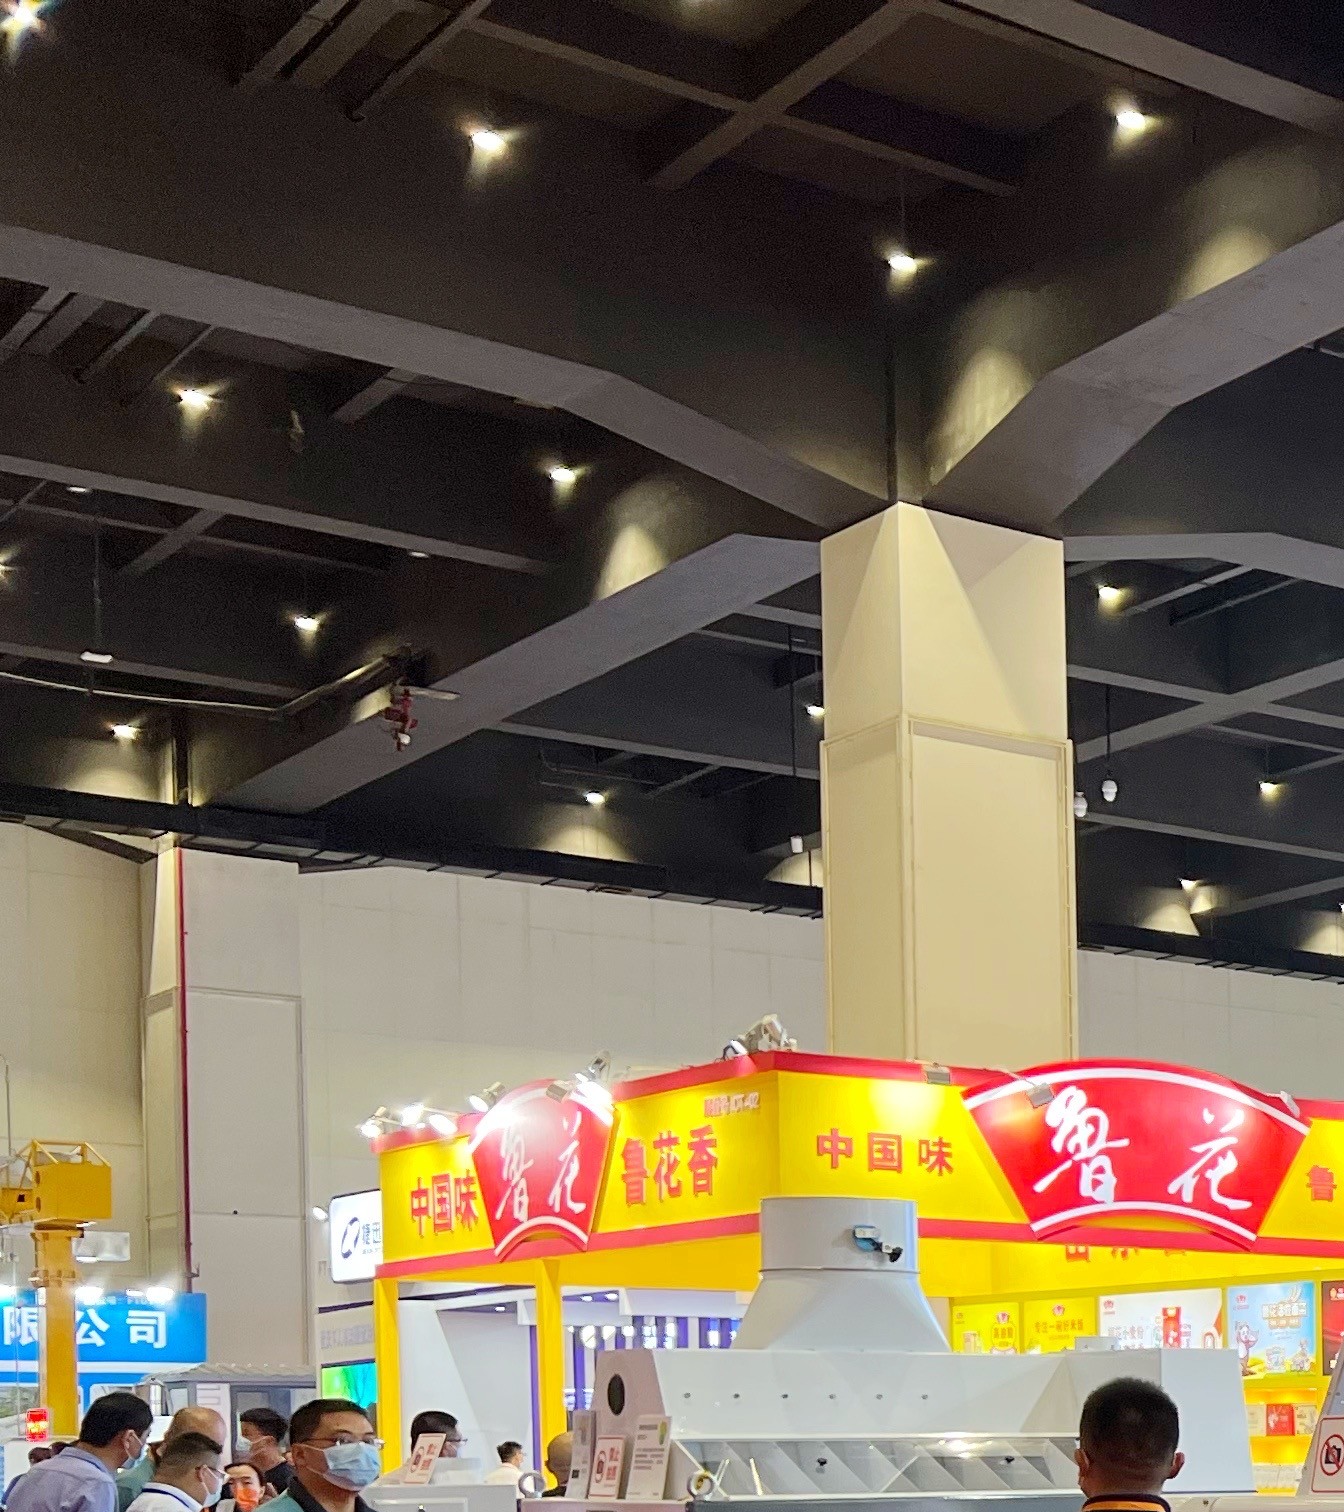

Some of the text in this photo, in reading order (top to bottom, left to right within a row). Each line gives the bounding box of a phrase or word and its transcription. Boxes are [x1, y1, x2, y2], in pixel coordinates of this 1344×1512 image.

[621, 1124, 718, 1208] 鲁花香
[816, 1127, 954, 1176] 中国味
[1033, 1085, 1252, 1210] 鲁花
[409, 1170, 479, 1238] 中国味
